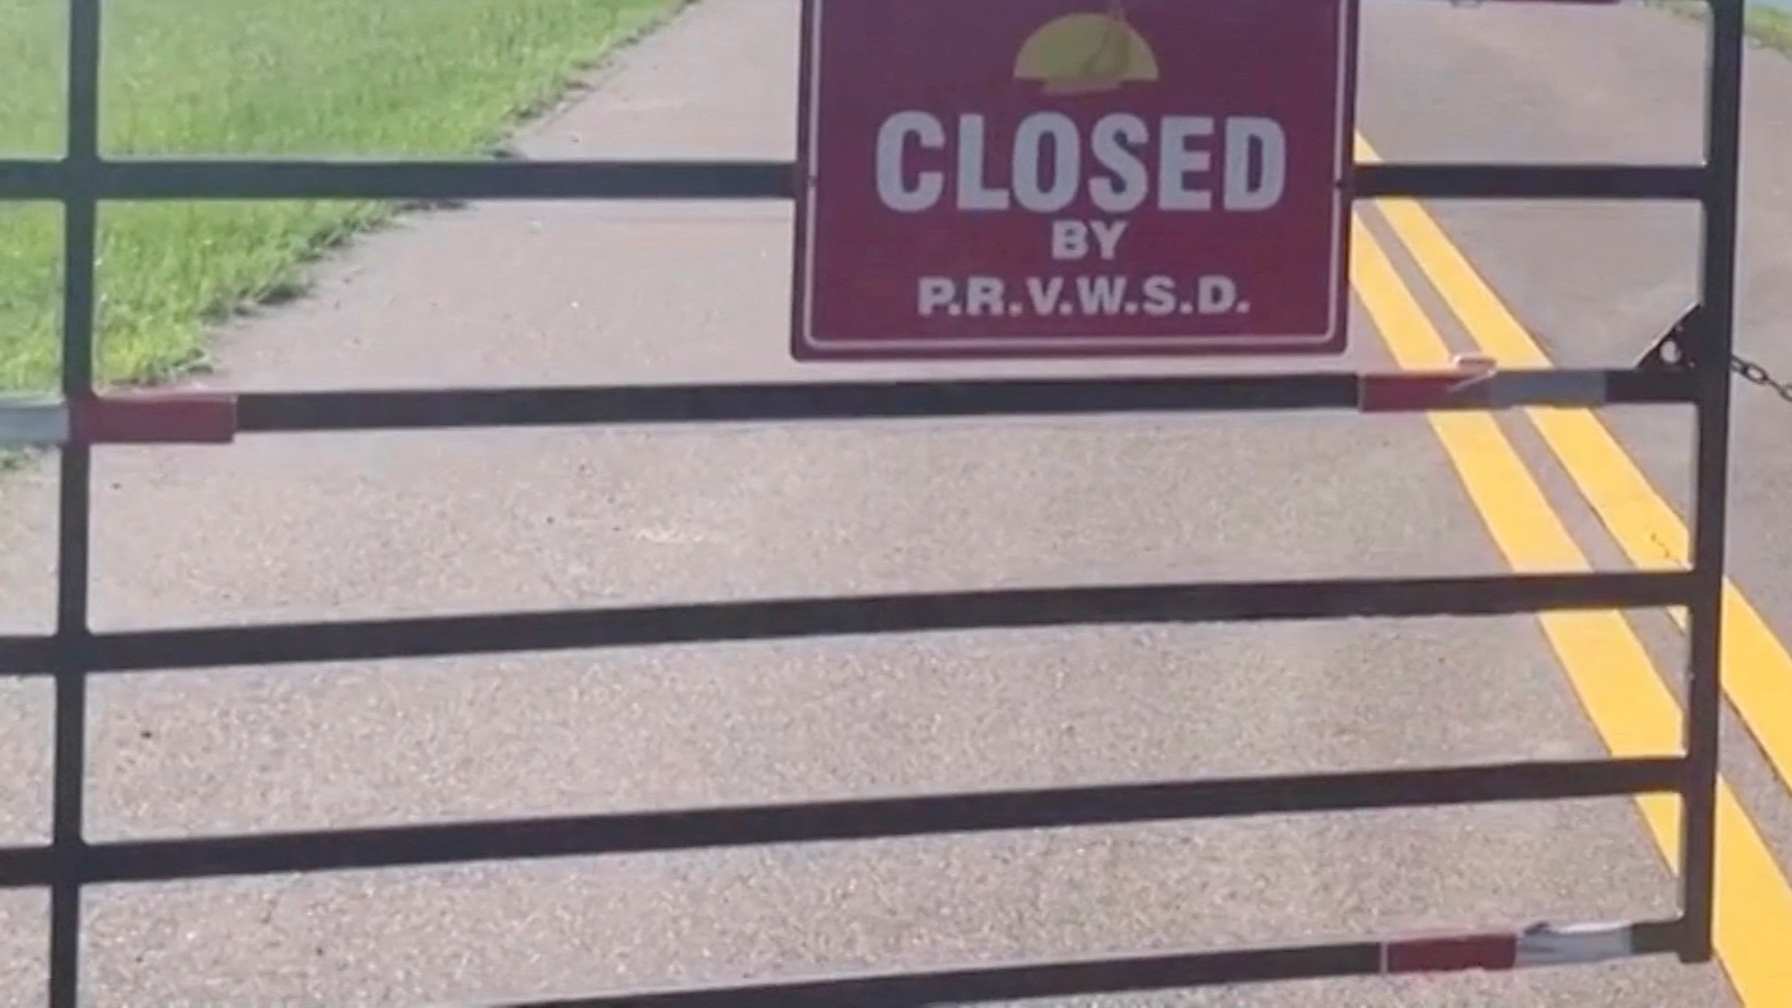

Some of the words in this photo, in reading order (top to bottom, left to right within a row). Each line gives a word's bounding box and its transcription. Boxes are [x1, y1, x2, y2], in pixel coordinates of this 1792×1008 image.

[875, 111, 1287, 213] CLOSED
[1051, 220, 1128, 260] BY
[917, 276, 1251, 316] P.R.V.W.S.D.
